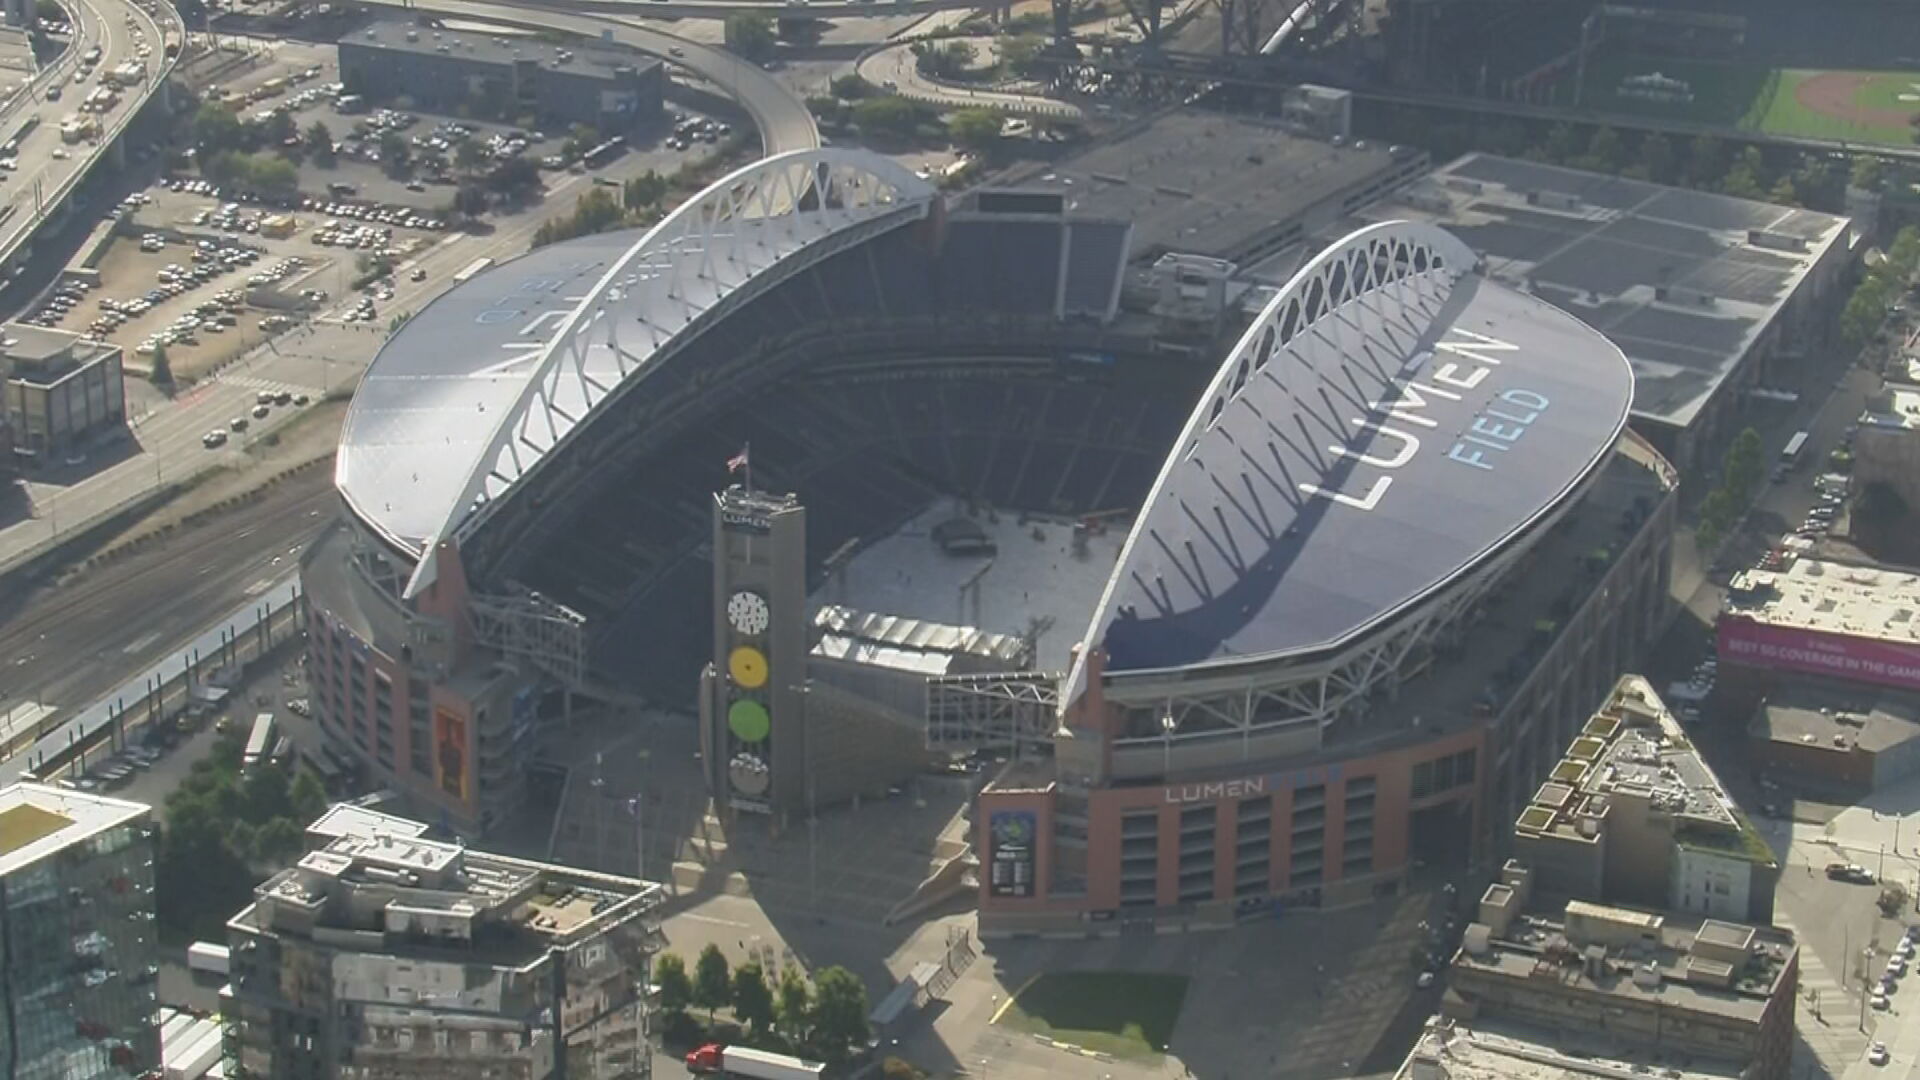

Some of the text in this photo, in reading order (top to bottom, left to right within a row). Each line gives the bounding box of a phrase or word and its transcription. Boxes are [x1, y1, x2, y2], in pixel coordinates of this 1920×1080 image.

[1299, 327, 1520, 511] LUMEN
[1449, 389, 1549, 470] FIELD
[1728, 639, 1757, 654] BEST
[1779, 646, 1844, 669] COVERAGE
[1845, 657, 1860, 670] IN
[1861, 659, 1886, 675] THE
[1165, 777, 1264, 803] LUMEN
